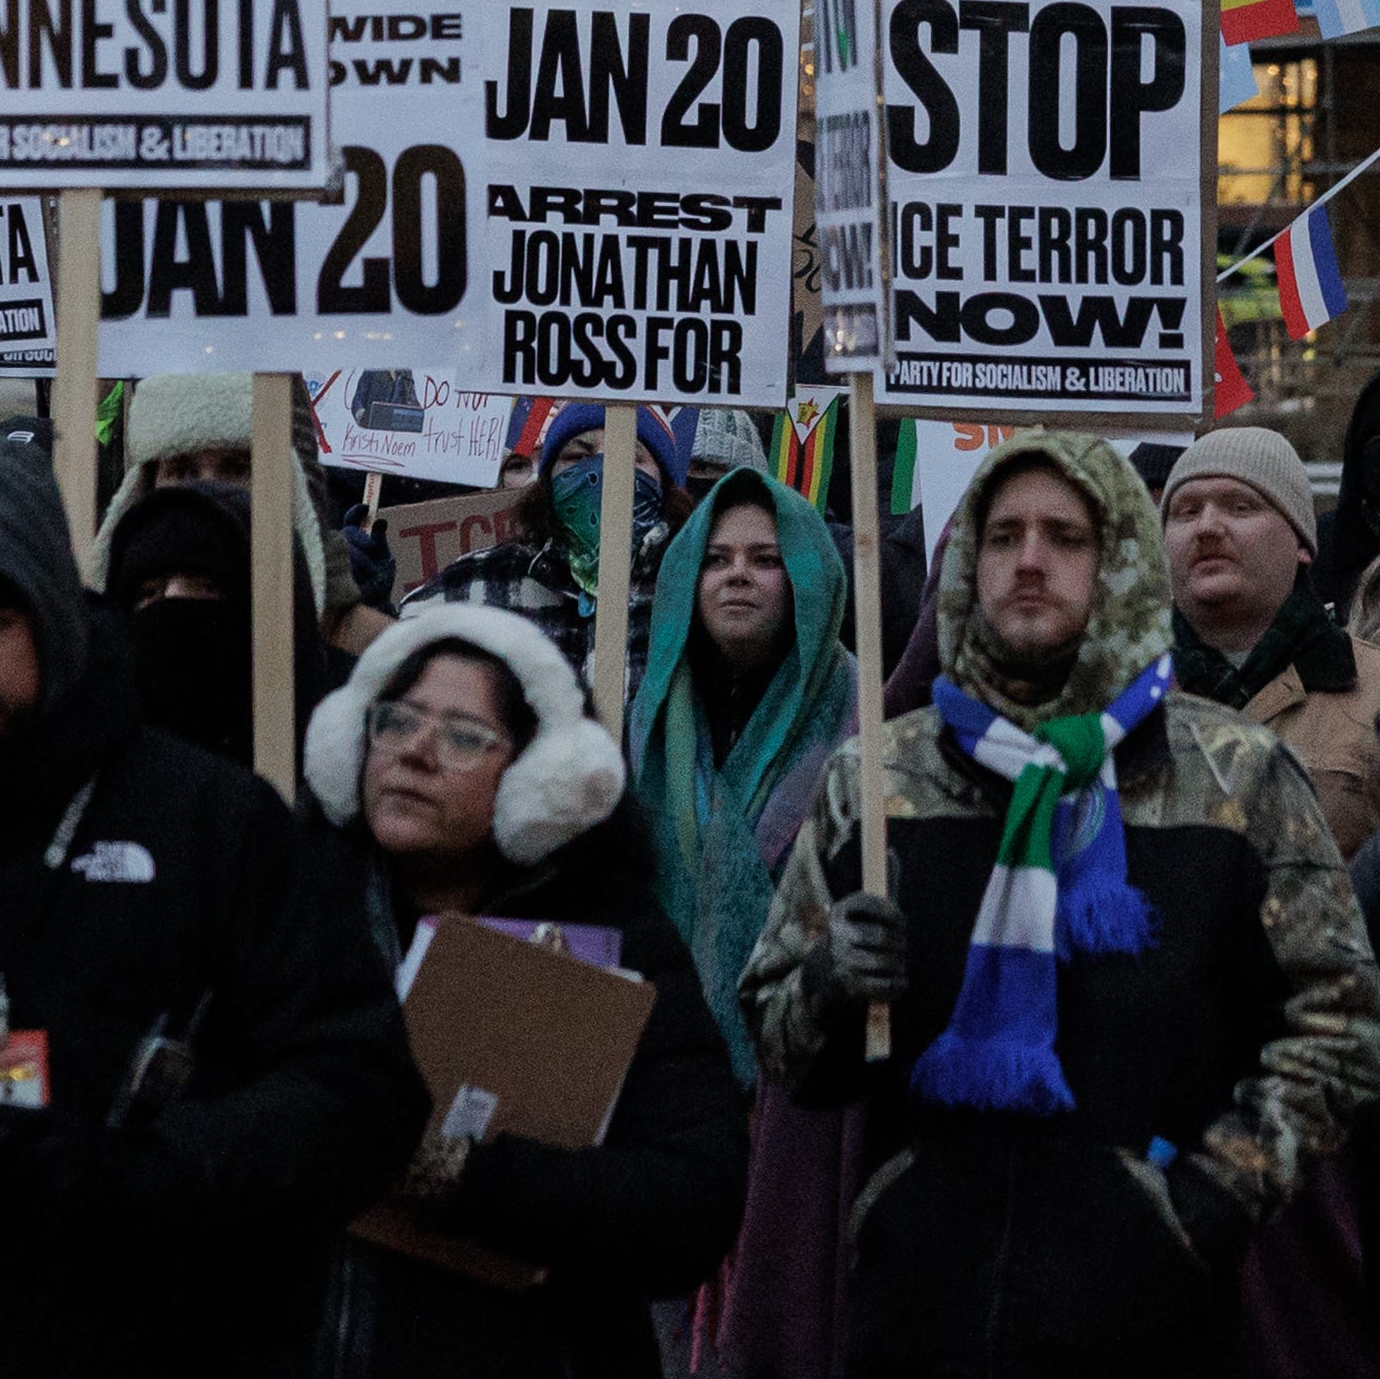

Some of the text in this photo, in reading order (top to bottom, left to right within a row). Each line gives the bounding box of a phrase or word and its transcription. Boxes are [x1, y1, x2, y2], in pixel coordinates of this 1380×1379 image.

[484, 7, 783, 152] JAN 20
[12, 124, 136, 162] SOCIALISM
[140, 126, 169, 161] &
[173, 124, 307, 163] LIBERATION
[101, 144, 468, 321] JAN 20
[487, 184, 782, 233] ARREST
[975, 204, 1185, 286] TERROR
[492, 229, 758, 316] JONATHAN
[502, 309, 637, 390] ROSS
[644, 316, 743, 395] FOR
[894, 289, 1187, 349] NOW!
[890, 360, 1185, 395] PARTY FOR SOCIALISM & LIBERATION
